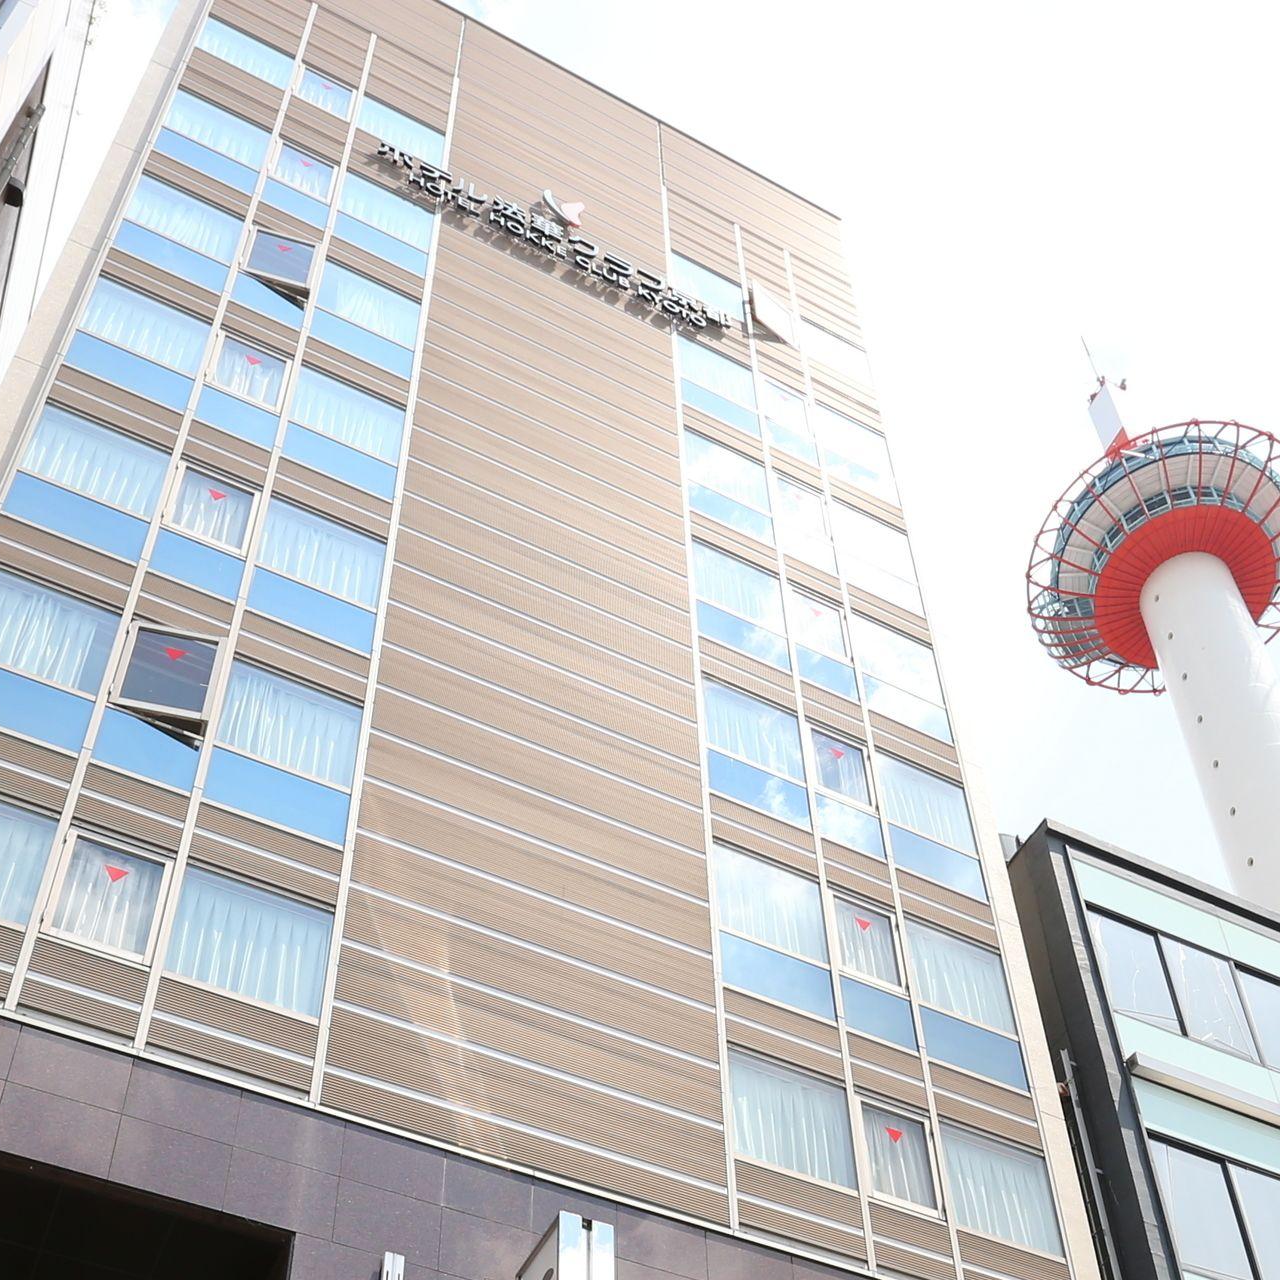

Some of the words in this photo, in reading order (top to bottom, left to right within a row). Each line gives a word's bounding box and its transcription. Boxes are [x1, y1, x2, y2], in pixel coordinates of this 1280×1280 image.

[408, 172, 481, 217] HOTEL
[489, 211, 568, 260] HOKKE
[575, 255, 631, 291] CLUB
[637, 284, 707, 328] KYOTO
